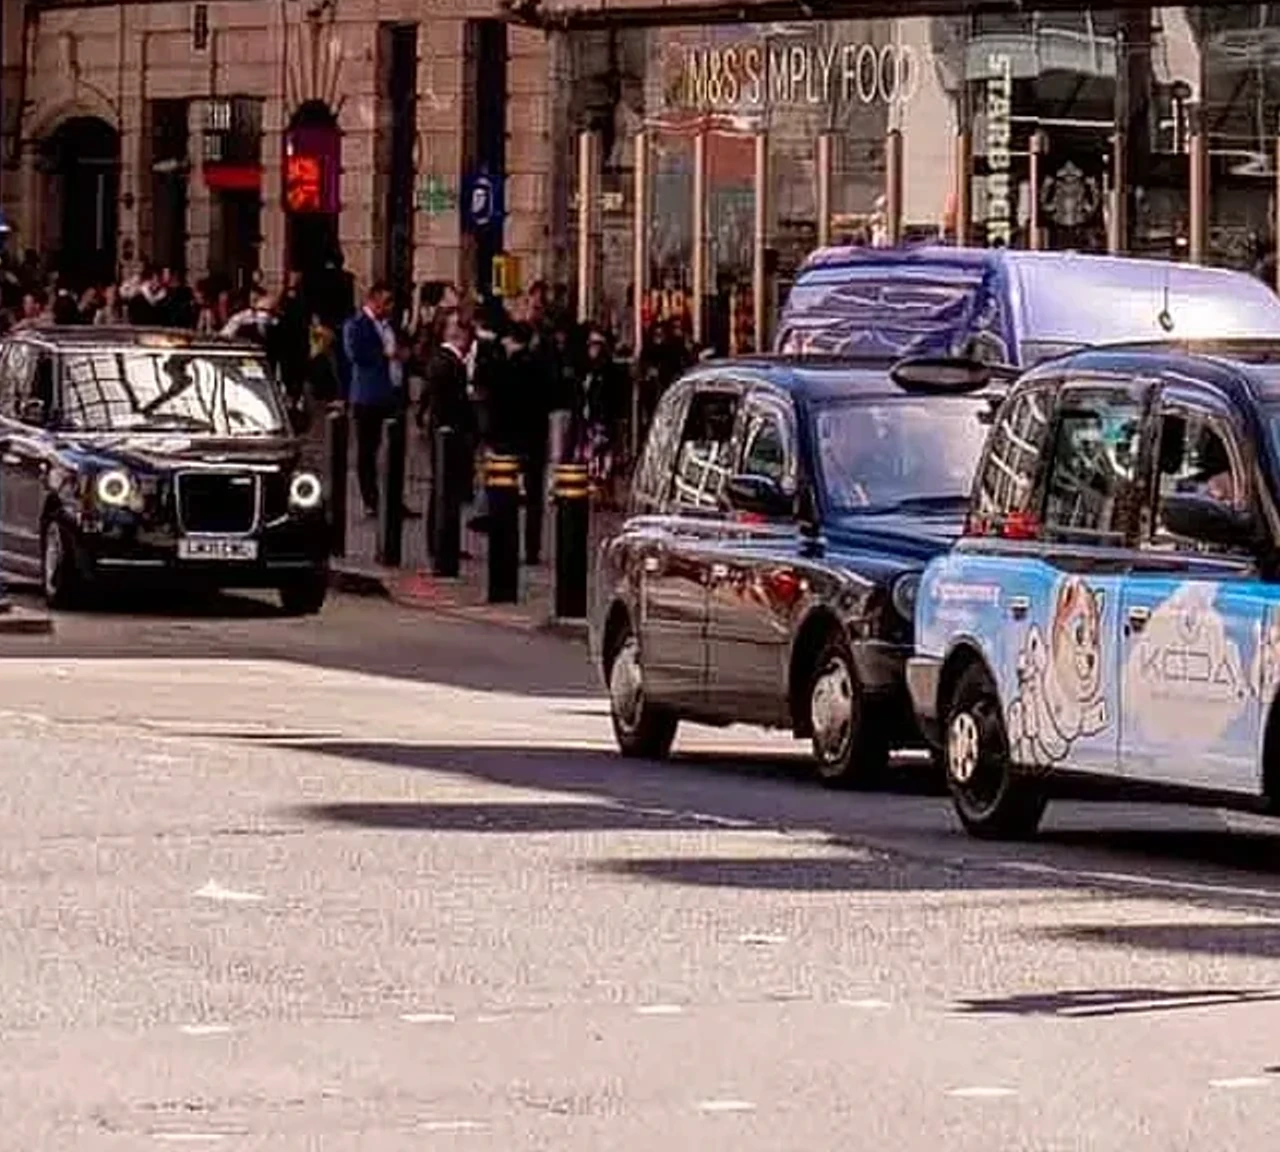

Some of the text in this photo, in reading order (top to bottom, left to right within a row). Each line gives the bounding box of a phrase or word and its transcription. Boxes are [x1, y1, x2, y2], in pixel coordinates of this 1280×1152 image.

[687, 43, 919, 105] M&S SMPLY FOOD
[986, 53, 1012, 246] STARBUCK
